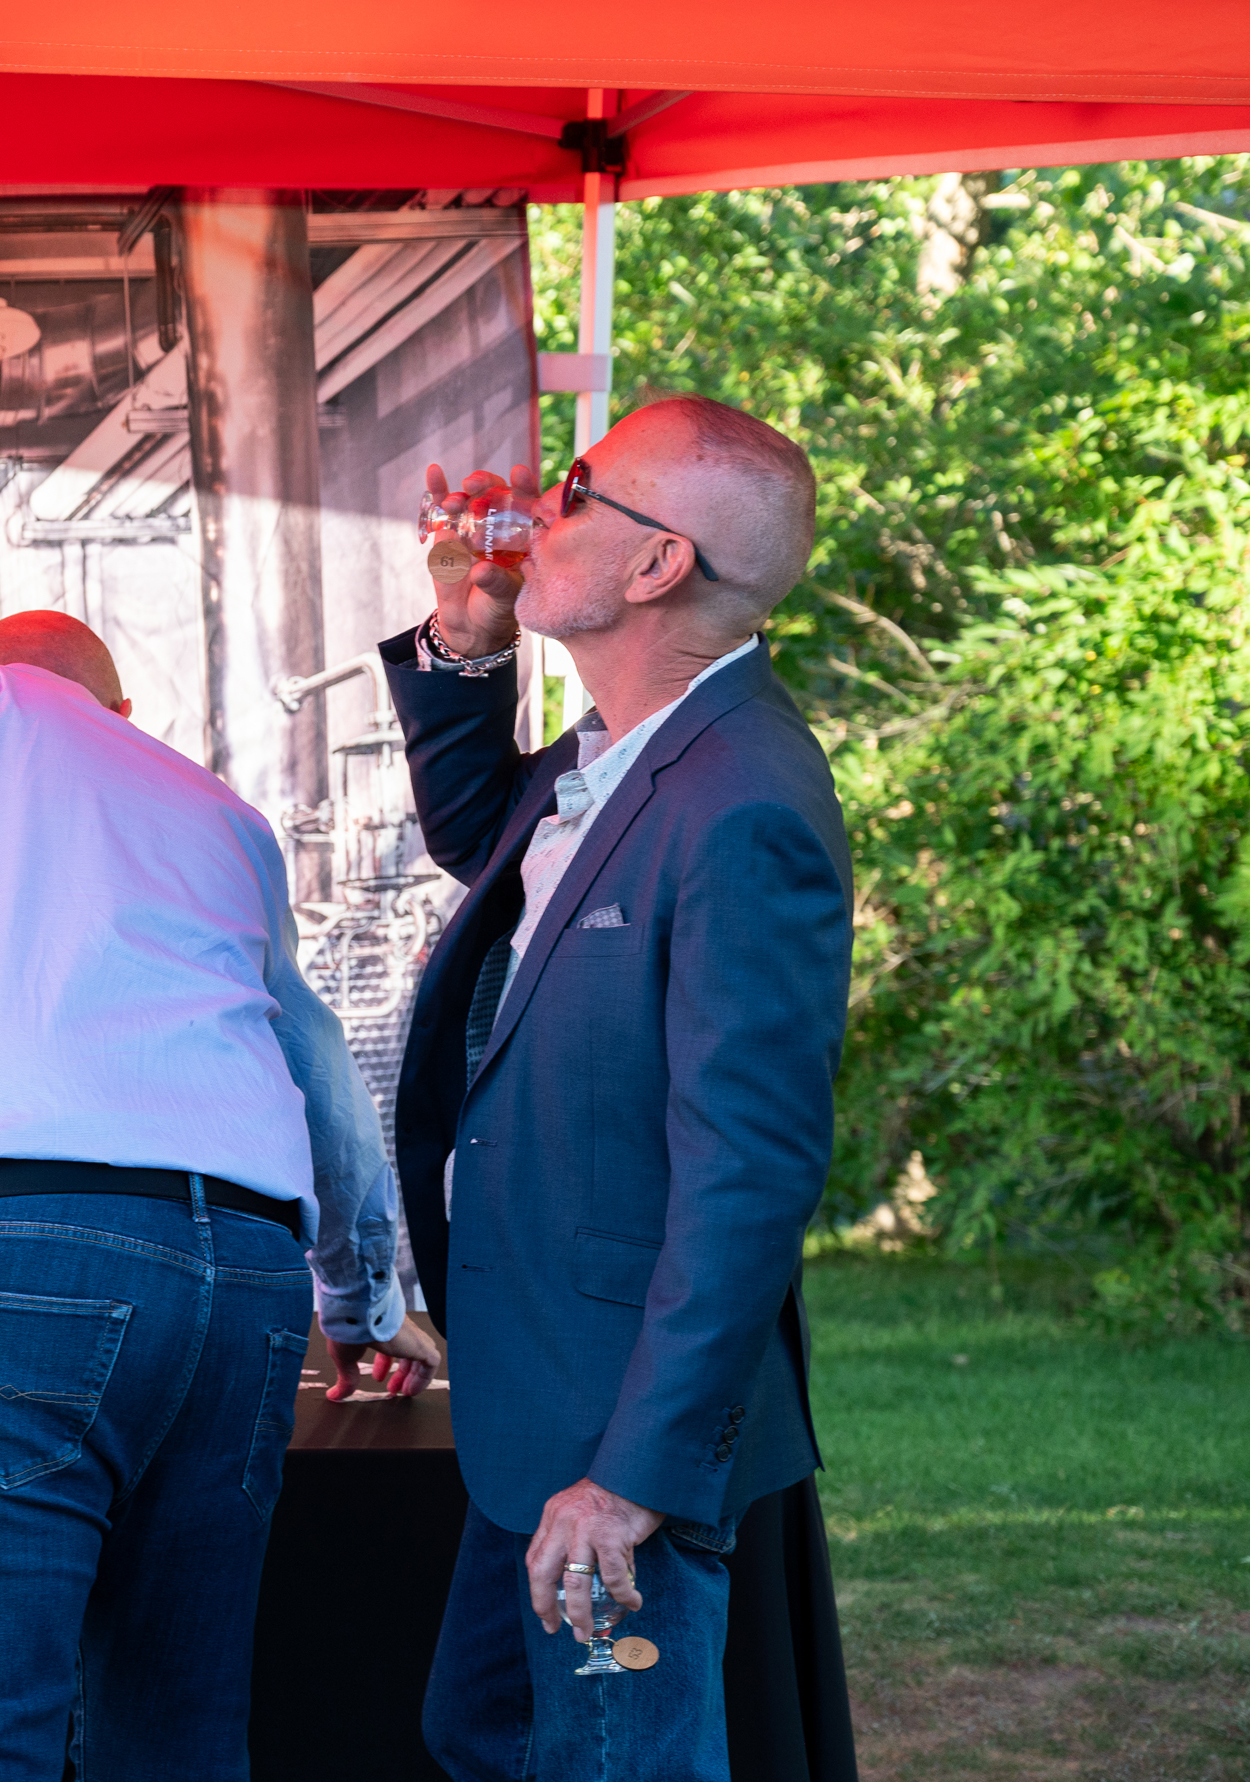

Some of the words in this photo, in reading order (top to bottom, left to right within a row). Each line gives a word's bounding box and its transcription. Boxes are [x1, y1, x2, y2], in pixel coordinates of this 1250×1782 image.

[485, 508, 496, 560] LENNAR
[440, 555, 455, 568] 61
[628, 1647, 643, 1660] 53
